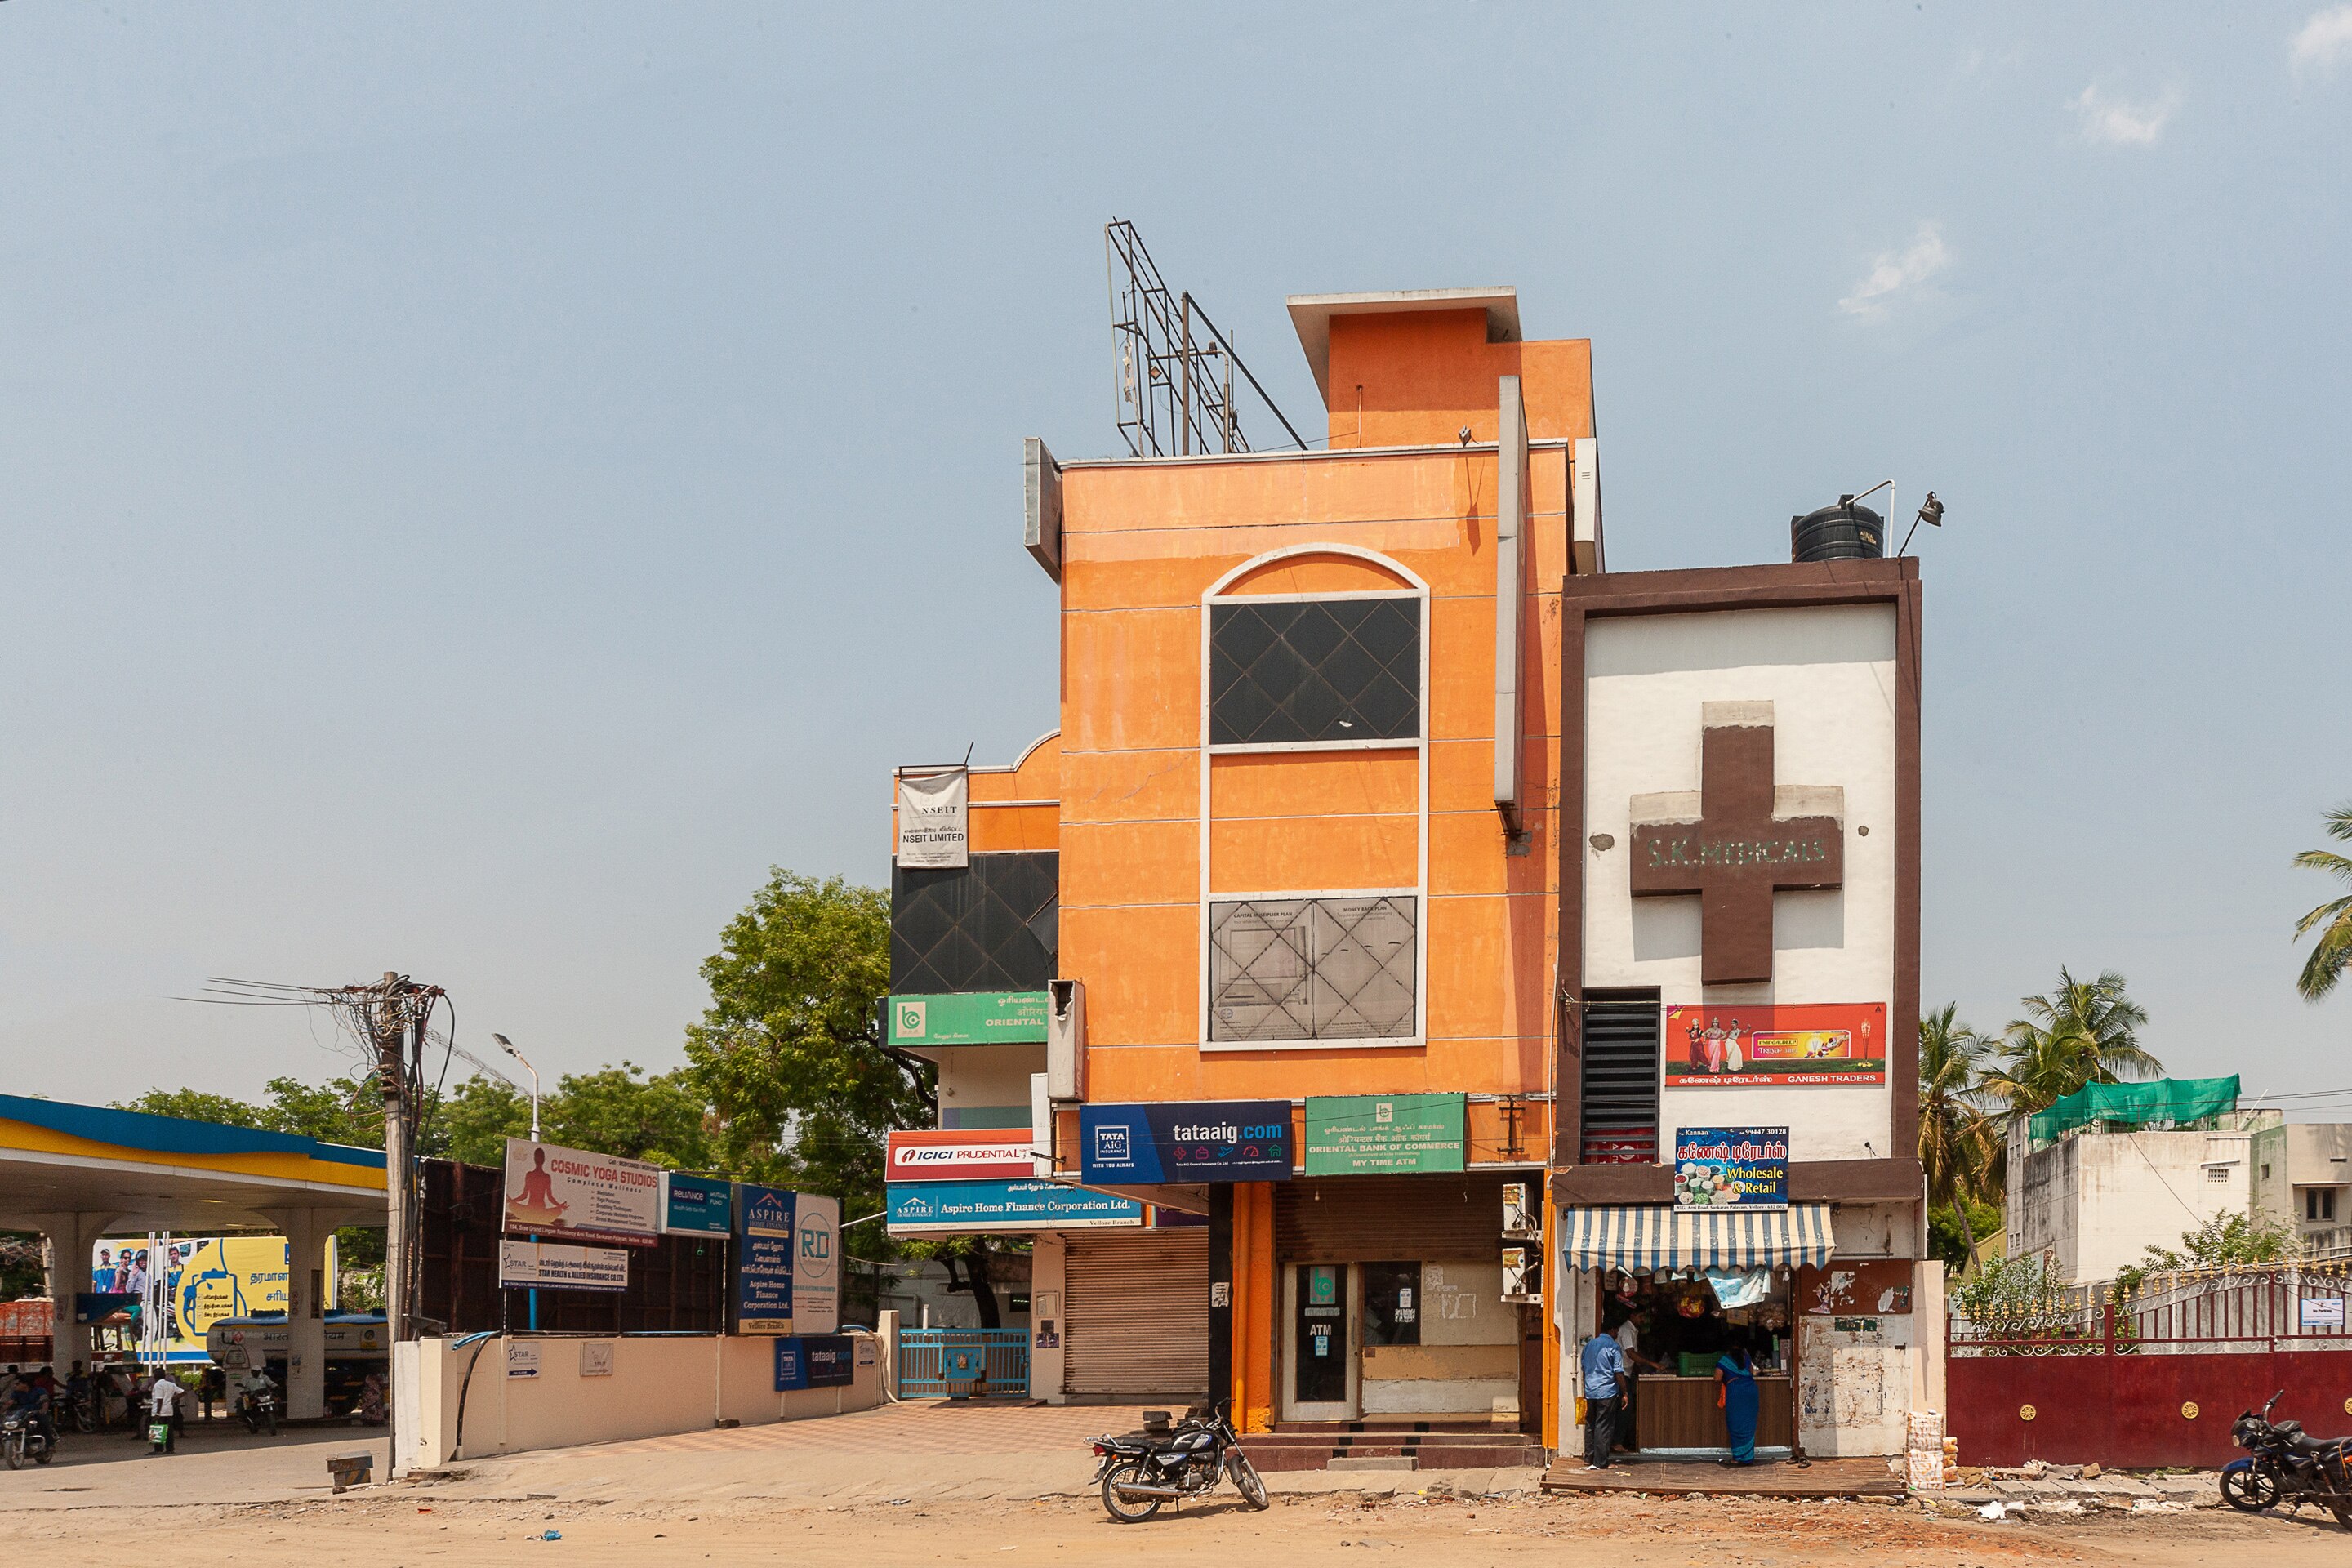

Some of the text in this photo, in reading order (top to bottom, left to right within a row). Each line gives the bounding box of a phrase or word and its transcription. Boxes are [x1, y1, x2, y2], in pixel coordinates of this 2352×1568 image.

[922, 805, 957, 814] NSEIT
[902, 833, 964, 843] NSEIT LIMITED
[1788, 1075, 1828, 1083] GANESH
[1173, 1121, 1282, 1143] tataaig.com
[1103, 1140, 1122, 1149] AIG
[917, 1148, 1020, 1160] ICICI PRUDENTIAL
[1677, 1141, 1786, 1163] கணேஷ் டிரேடர்ஸ்
[551, 1159, 657, 1188] COSMIC YOGA STUDIOS
[1726, 1166, 1783, 1178] Wholesale
[567, 1176, 642, 1193] Complete Wellness
[1733, 1182, 1776, 1194] & Retail
[941, 1199, 1130, 1215] Aspire Home Finance Corporation Ltd.
[748, 1209, 790, 1223] ASPIRE
[800, 1229, 830, 1258] RD
[539, 1269, 550, 1277] STAR
[551, 1270, 567, 1278] HEALTH
[572, 1271, 586, 1279] ALLIED
[586, 1272, 609, 1281] INSURANCE
[749, 1280, 768, 1290] Aspire
[768, 1281, 786, 1289] Home
[755, 1290, 778, 1298] Finance
[743, 1301, 777, 1311] Corporation
[768, 1321, 784, 1330] Branch
[1309, 1324, 1331, 1336] ATM
[812, 1349, 851, 1363] tataaig.com
